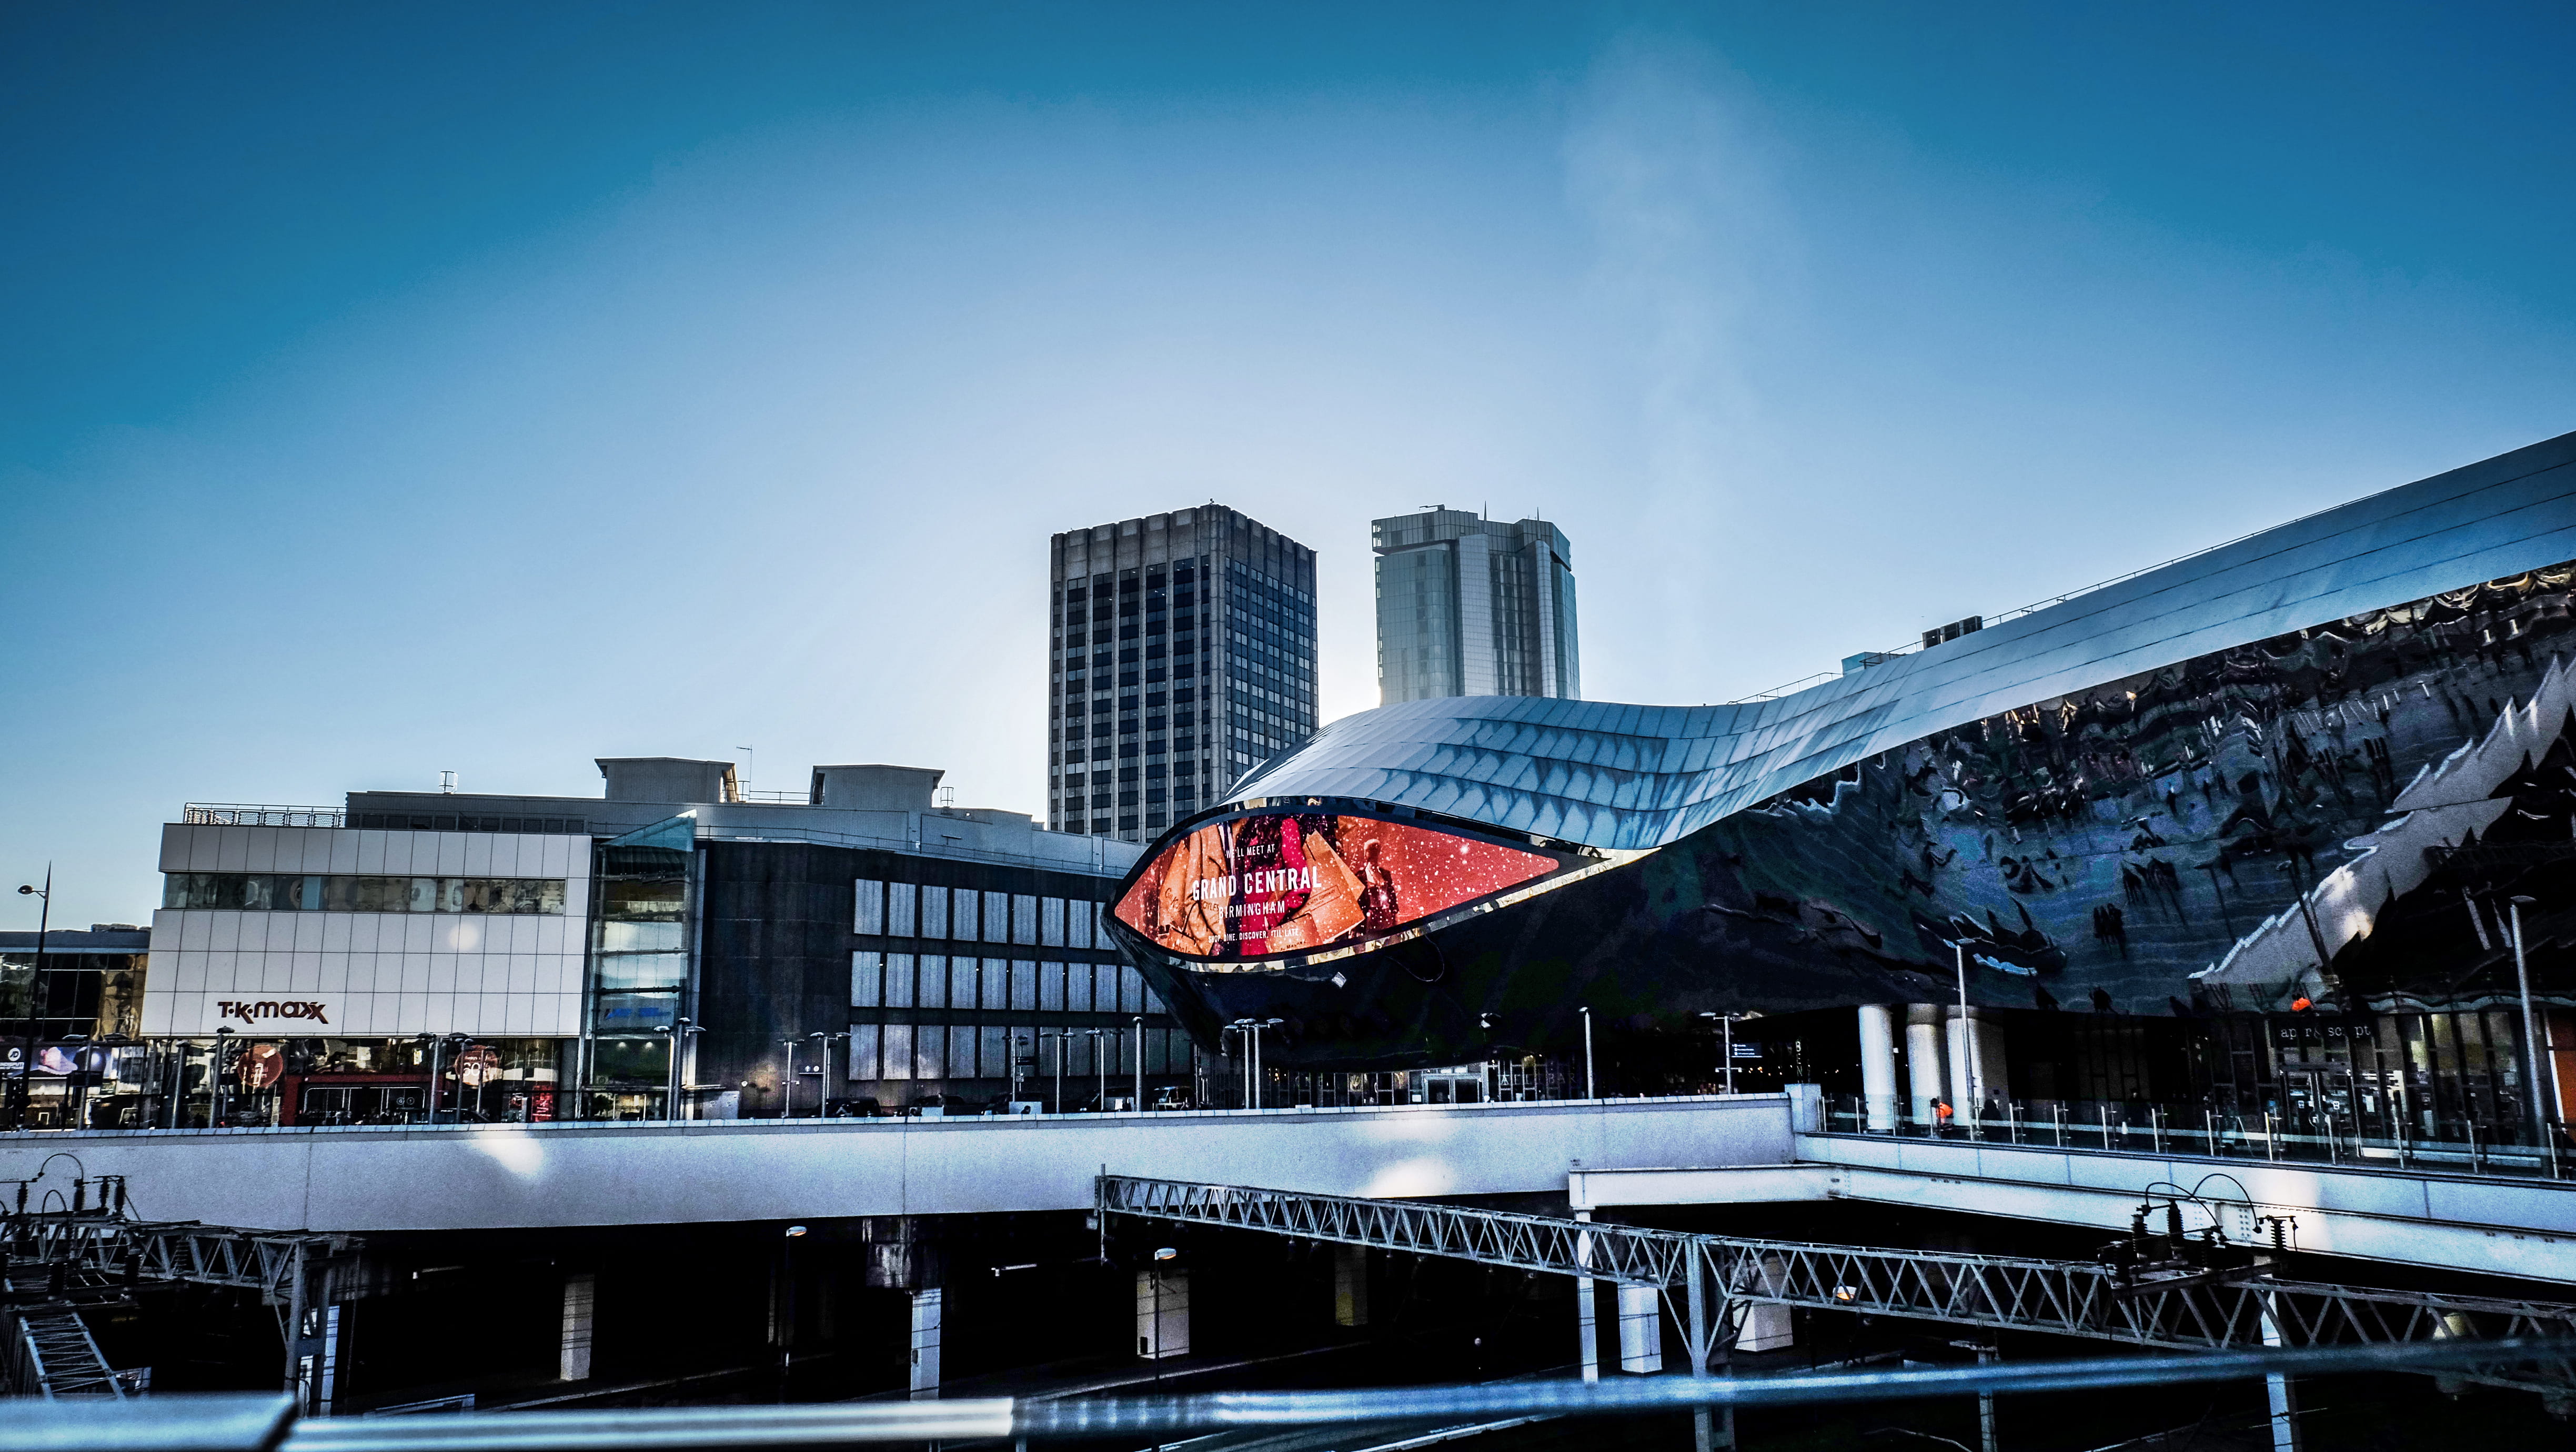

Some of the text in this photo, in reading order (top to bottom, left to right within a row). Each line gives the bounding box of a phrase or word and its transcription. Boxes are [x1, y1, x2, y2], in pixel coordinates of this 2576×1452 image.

[1226, 844, 1275, 859] WE'LL MEET AT
[1193, 875, 1236, 901] GRAND
[1244, 866, 1322, 894] CENTRAL
[1219, 900, 1285, 919] BIRMINGHAM
[1239, 931, 1269, 941] DISCOVER.
